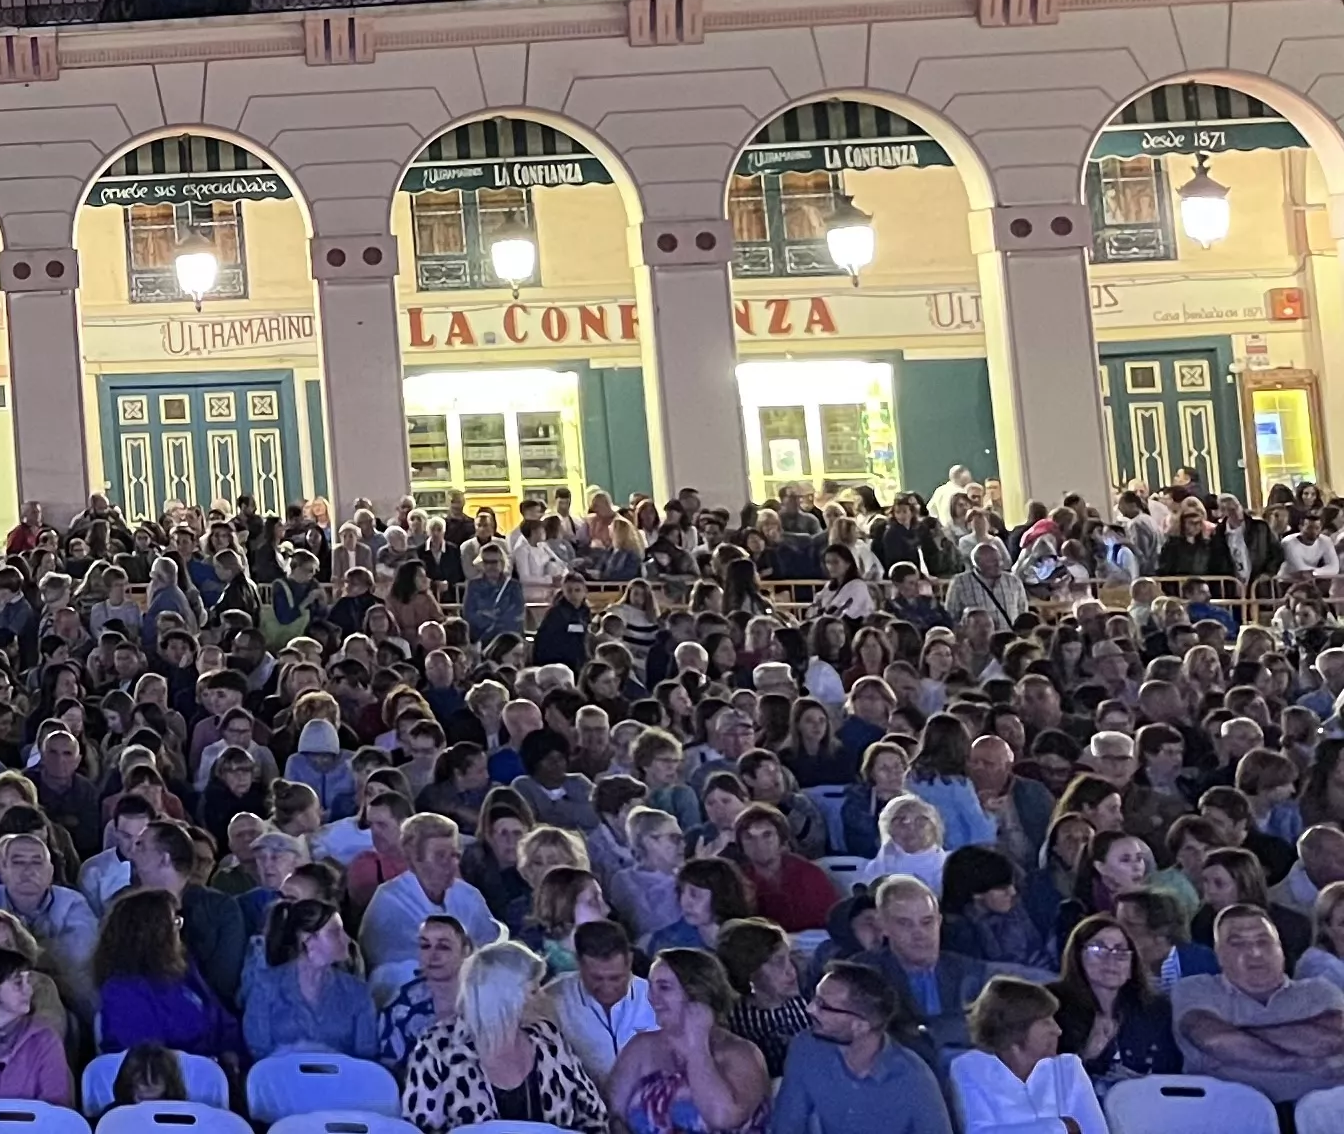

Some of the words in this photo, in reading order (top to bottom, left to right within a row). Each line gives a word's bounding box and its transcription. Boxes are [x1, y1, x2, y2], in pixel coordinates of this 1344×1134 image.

[1142, 131, 1185, 148] desde
[1193, 131, 1226, 148] 1871
[823, 146, 841, 169] LA
[845, 145, 919, 168] CONFIANZA
[494, 164, 511, 186] LA
[513, 163, 584, 186] CONFIANZA
[100, 182, 148, 204] pruebe
[154, 183, 177, 198] sus
[182, 177, 277, 201] especialidades
[165, 315, 313, 354] ULTRAMARINO
[407, 307, 476, 348] LA
